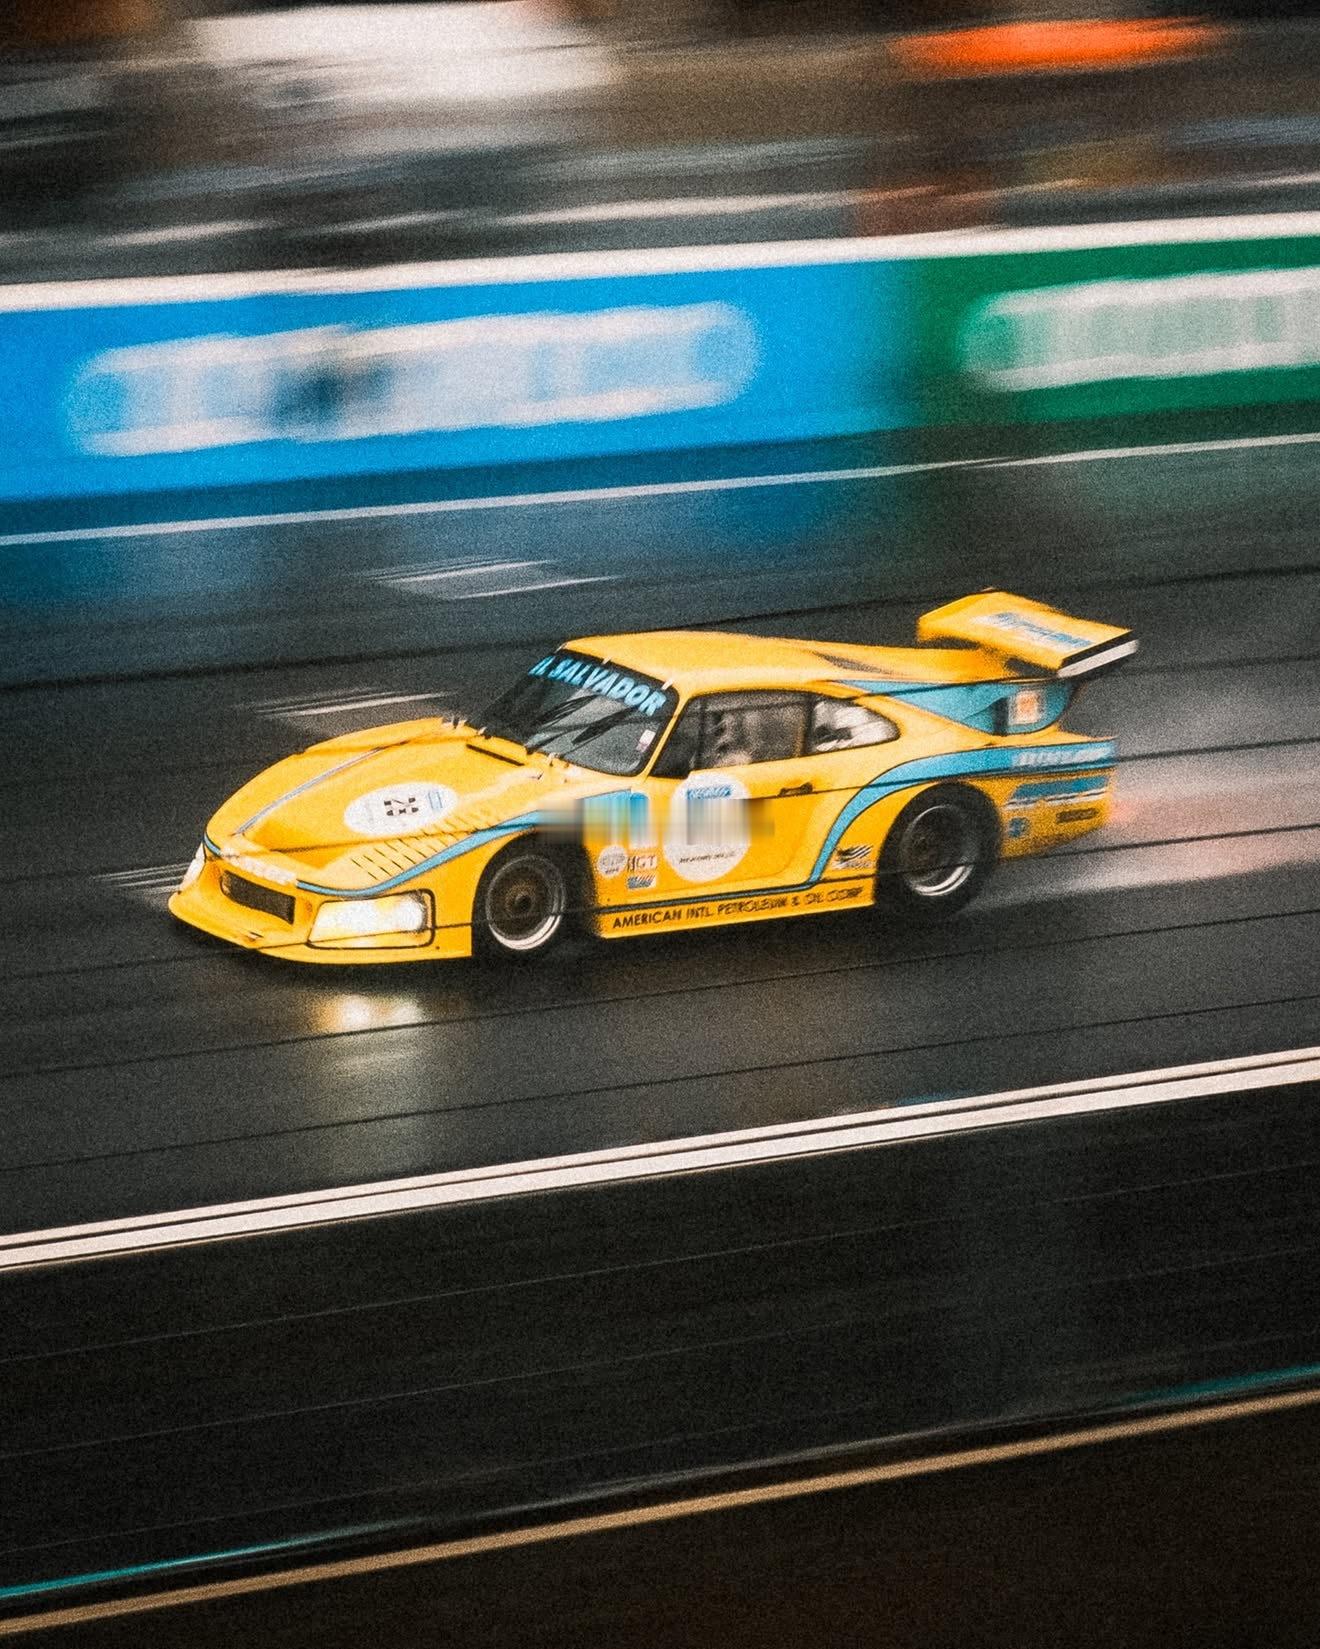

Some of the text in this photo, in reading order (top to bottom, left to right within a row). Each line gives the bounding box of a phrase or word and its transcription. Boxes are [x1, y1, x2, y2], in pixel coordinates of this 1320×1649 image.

[548, 659, 667, 716] SALVADOR
[612, 909, 682, 929] AMERICAN
[717, 898, 787, 915] PETROLEUM
